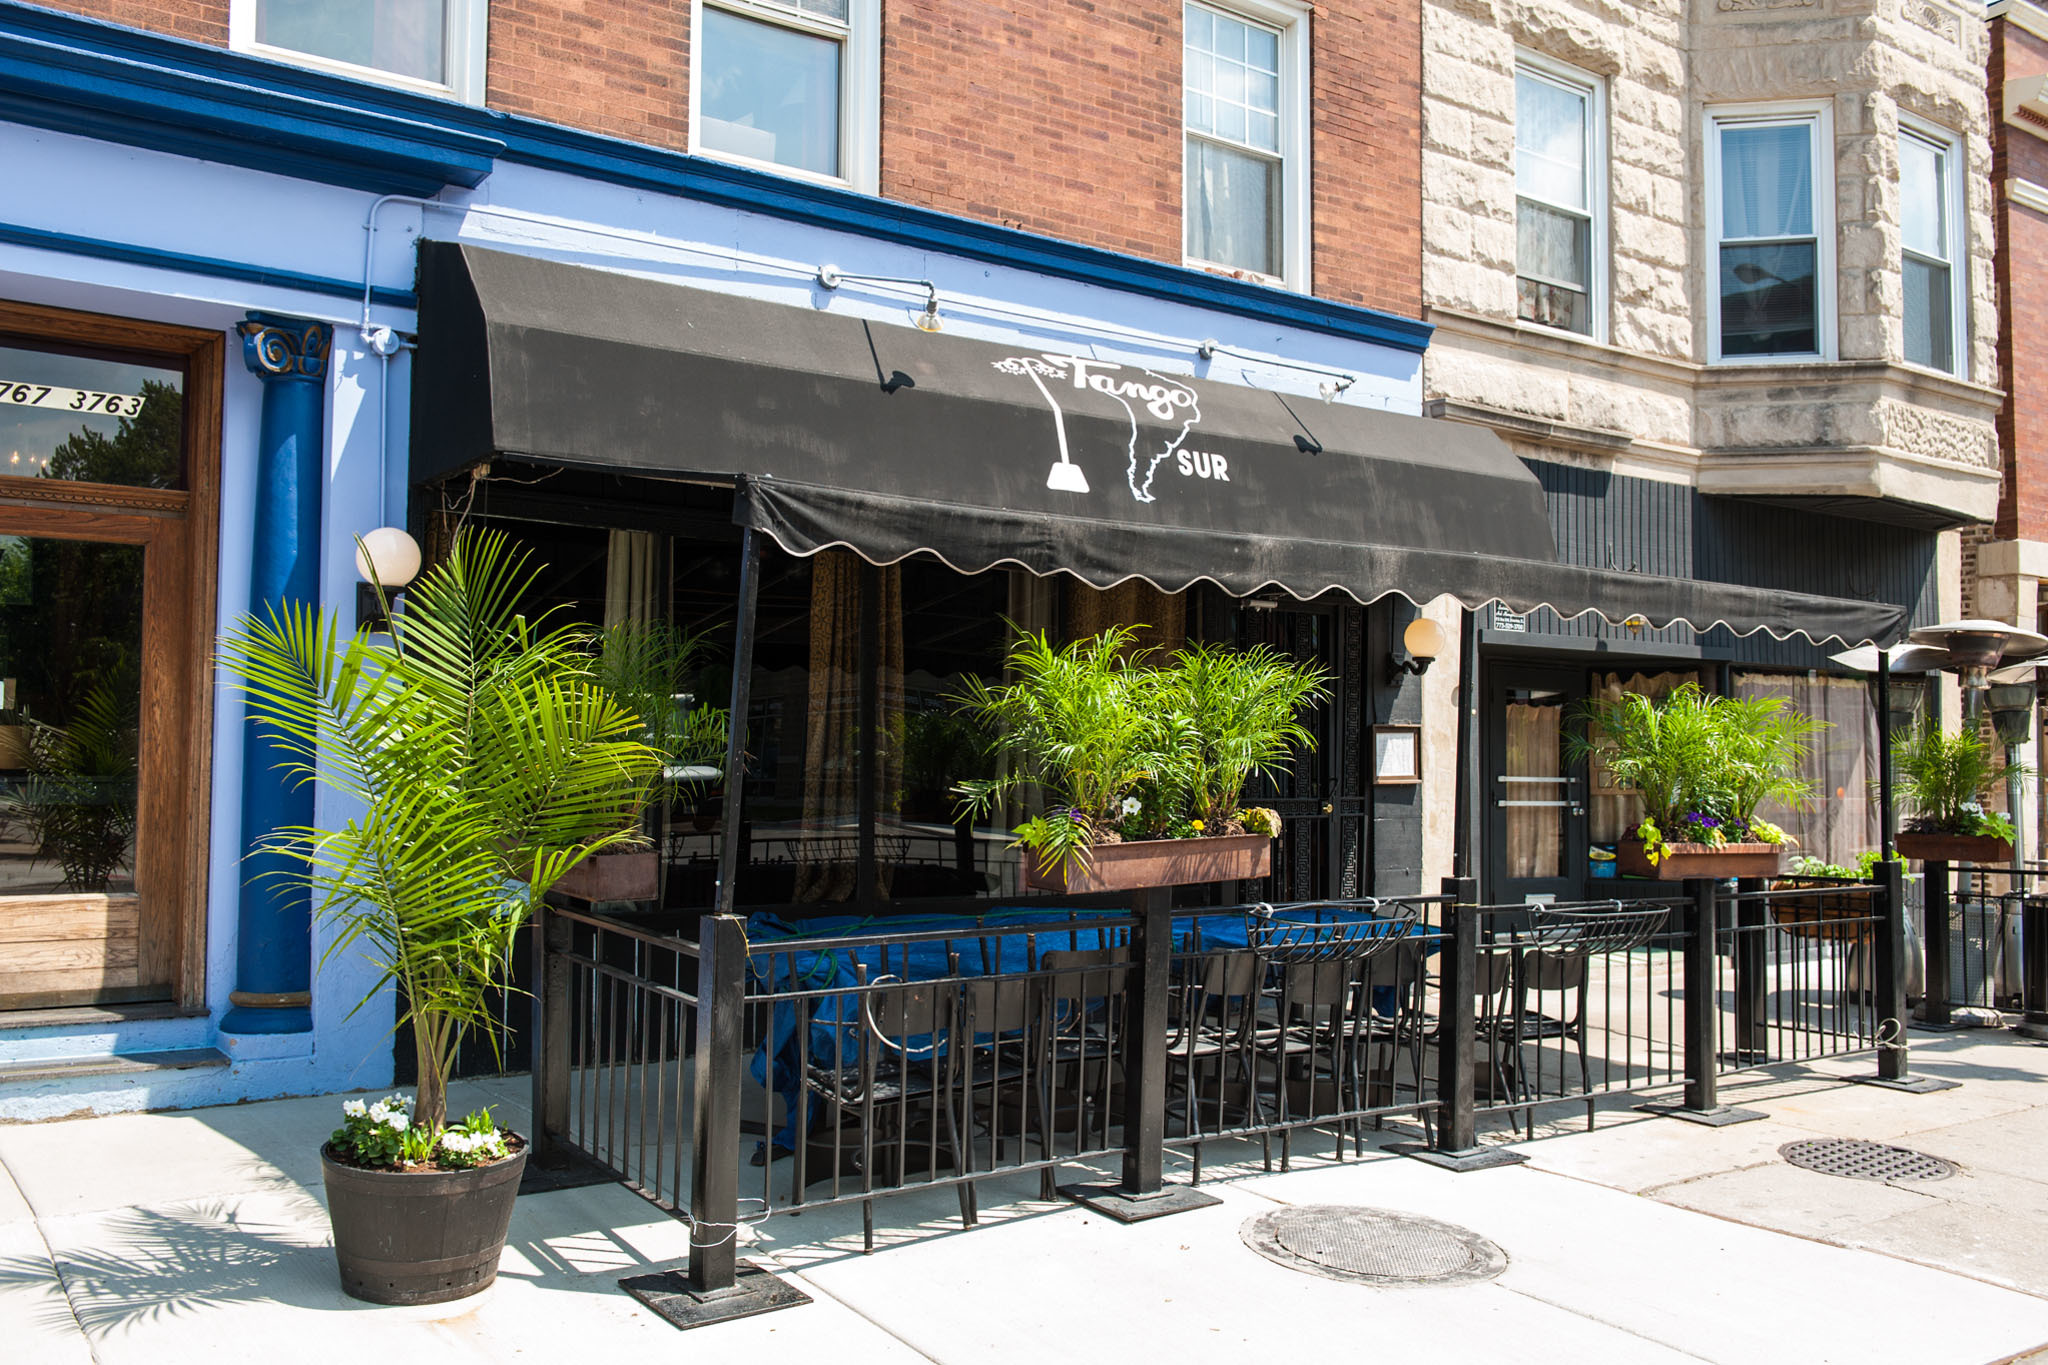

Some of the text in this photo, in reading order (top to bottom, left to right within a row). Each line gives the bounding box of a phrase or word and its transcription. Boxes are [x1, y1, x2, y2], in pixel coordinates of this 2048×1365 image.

[69, 391, 141, 416] 3763
[1041, 353, 1192, 420] Tango
[1177, 448, 1231, 482] SUR
